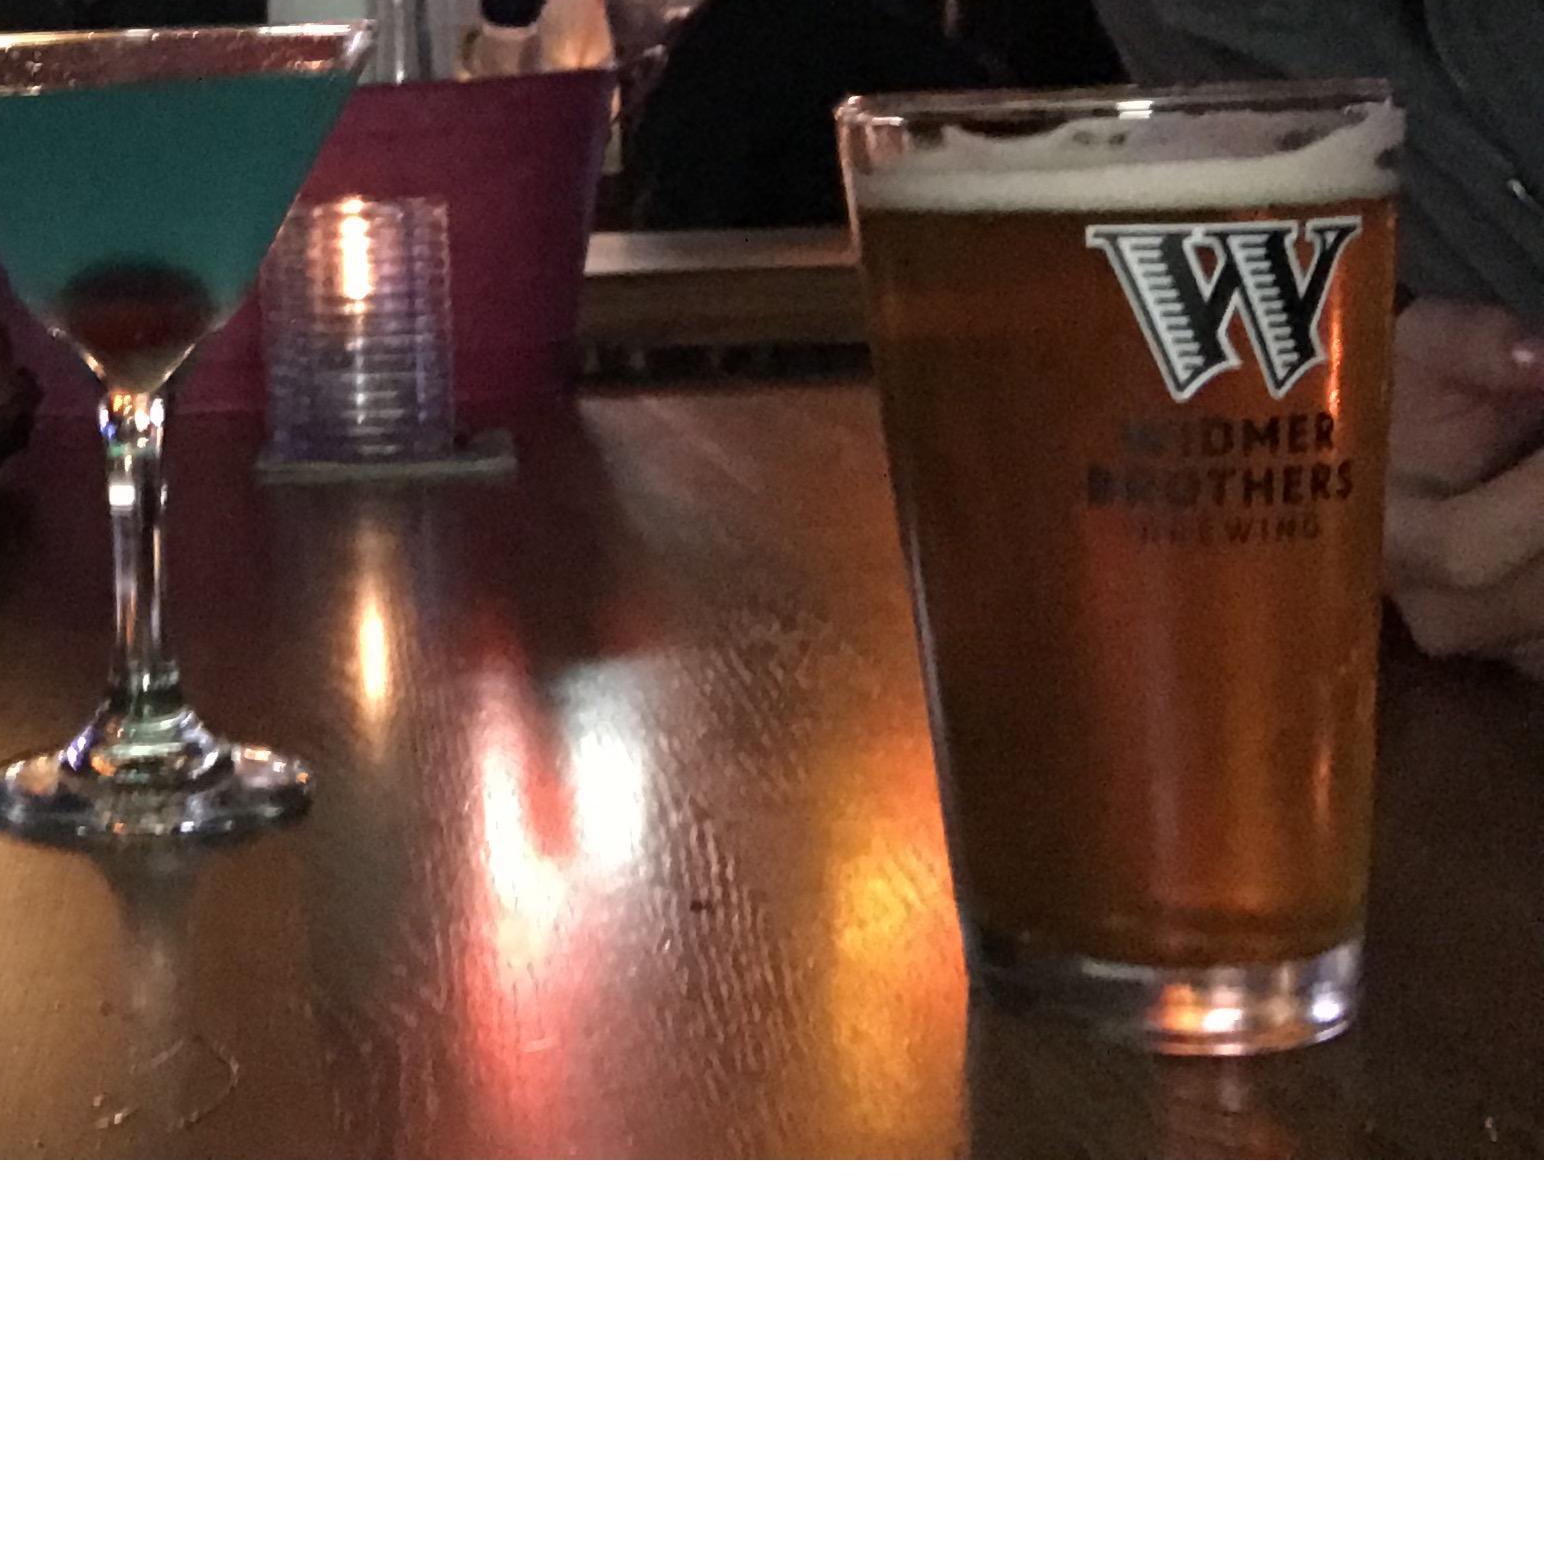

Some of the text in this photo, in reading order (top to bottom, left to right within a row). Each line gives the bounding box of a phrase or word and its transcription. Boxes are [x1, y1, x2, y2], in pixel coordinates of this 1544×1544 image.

[1085, 215, 1362, 403] W
[1120, 411, 1335, 458] IDMER
[1140, 514, 1320, 545] EWING
